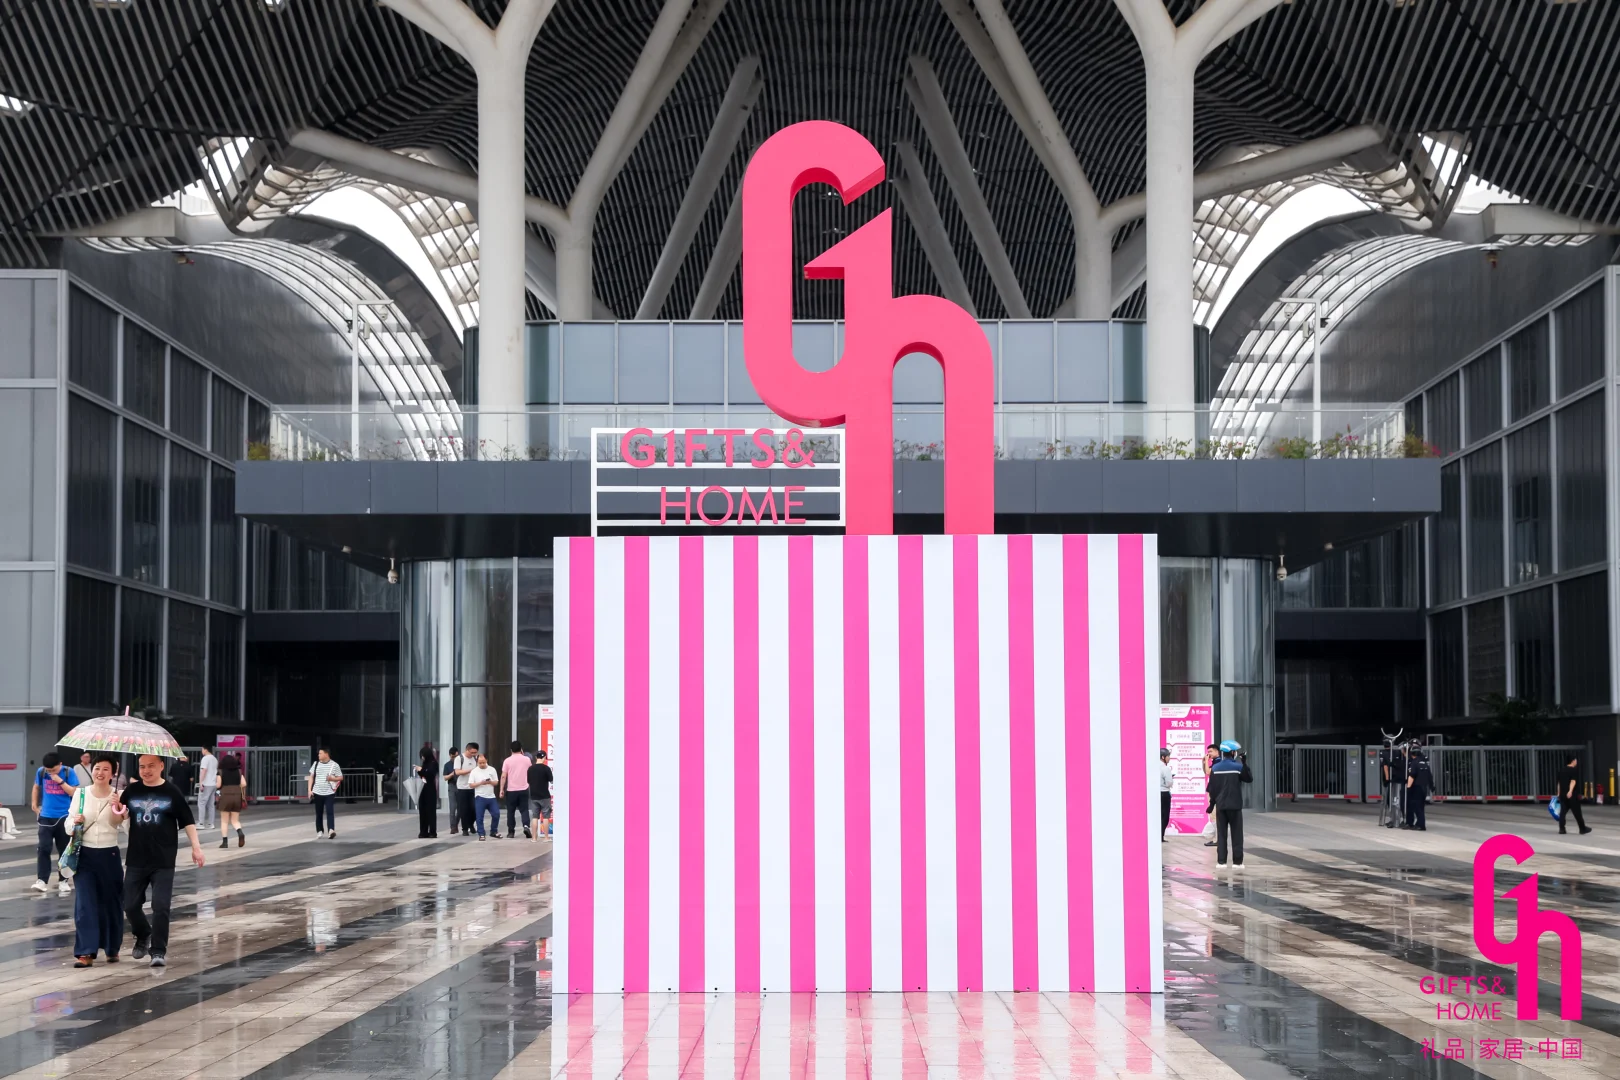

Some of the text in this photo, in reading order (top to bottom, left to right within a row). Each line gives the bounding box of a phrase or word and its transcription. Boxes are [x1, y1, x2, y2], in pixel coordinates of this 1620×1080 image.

[660, 485, 806, 526] HOME
[1170, 720, 1200, 728] 观众登记
[136, 813, 160, 823] BOY
